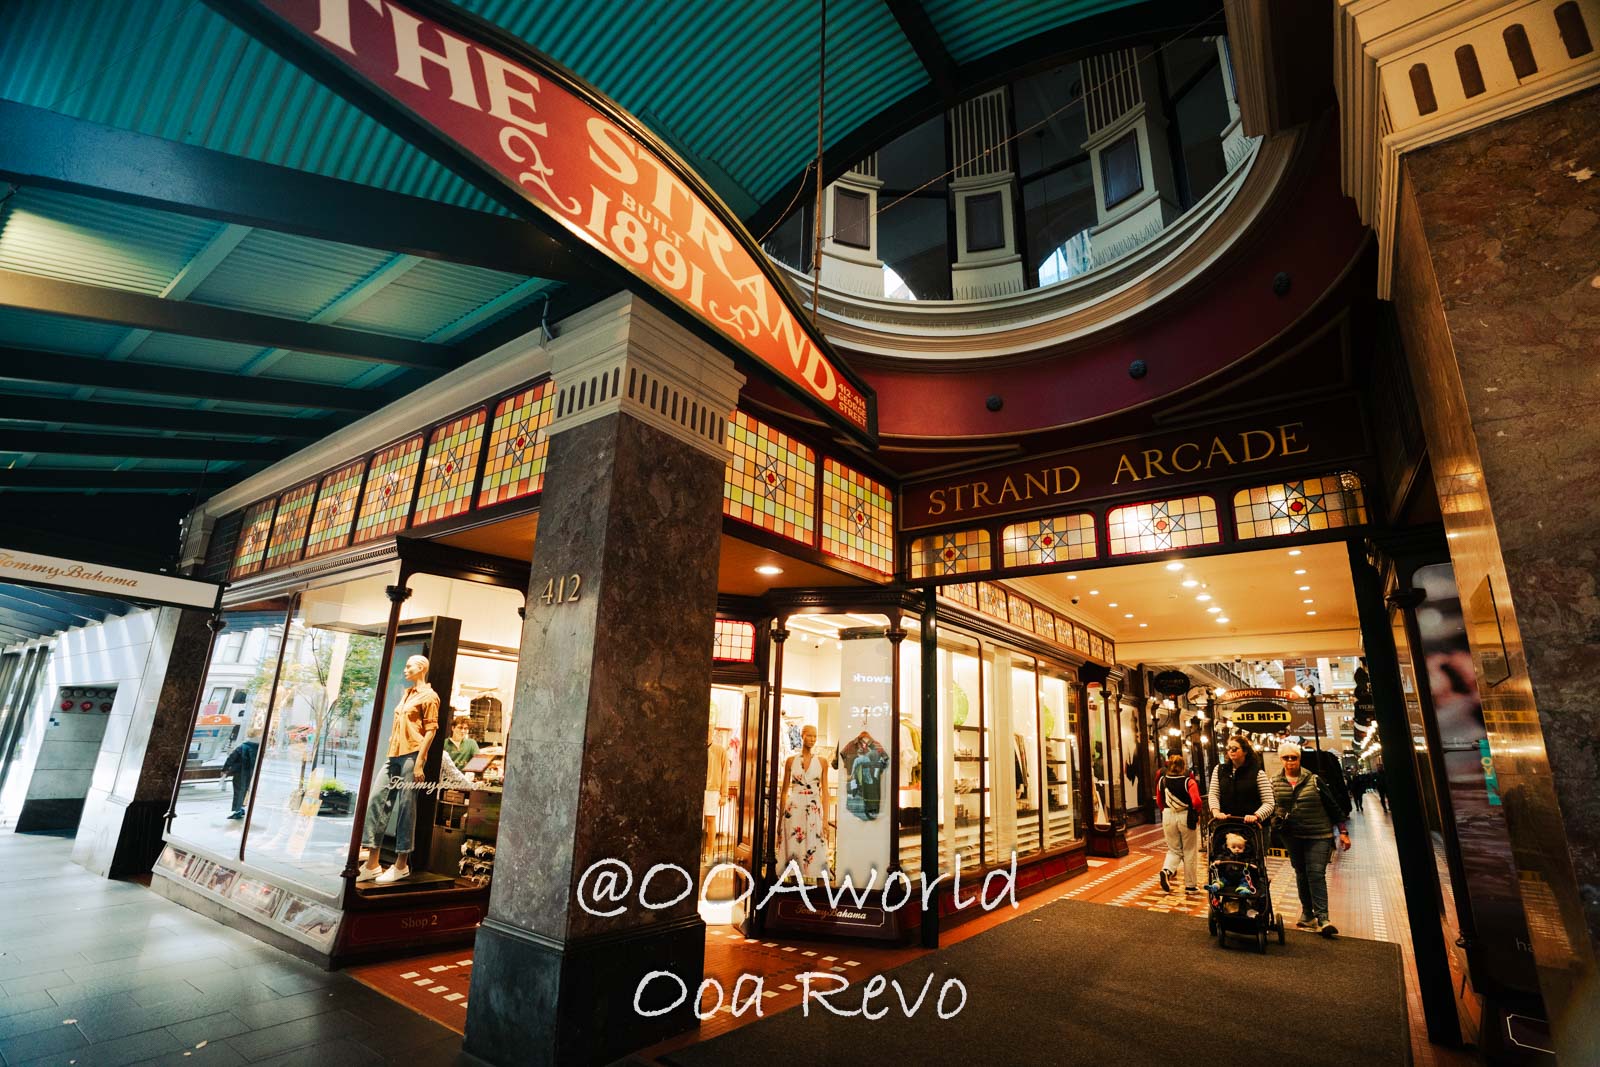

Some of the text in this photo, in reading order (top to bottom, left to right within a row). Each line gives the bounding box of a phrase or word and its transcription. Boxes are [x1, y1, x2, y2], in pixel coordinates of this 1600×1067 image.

[313, 0, 836, 401] THE STRAND
[621, 190, 685, 249] BUILT
[585, 184, 706, 313] 1891
[838, 391, 867, 420] GEORGE
[838, 401, 866, 427] STREET
[928, 421, 1310, 516] STRAND ARCADE
[0, 552, 139, 588] Tommy Bahama
[541, 573, 582, 605] 412
[1224, 689, 1294, 699] SHOPPING LIFT
[1236, 713, 1255, 721] JB
[384, 774, 438, 795] Tommy
[401, 914, 438, 929] Shop 2
